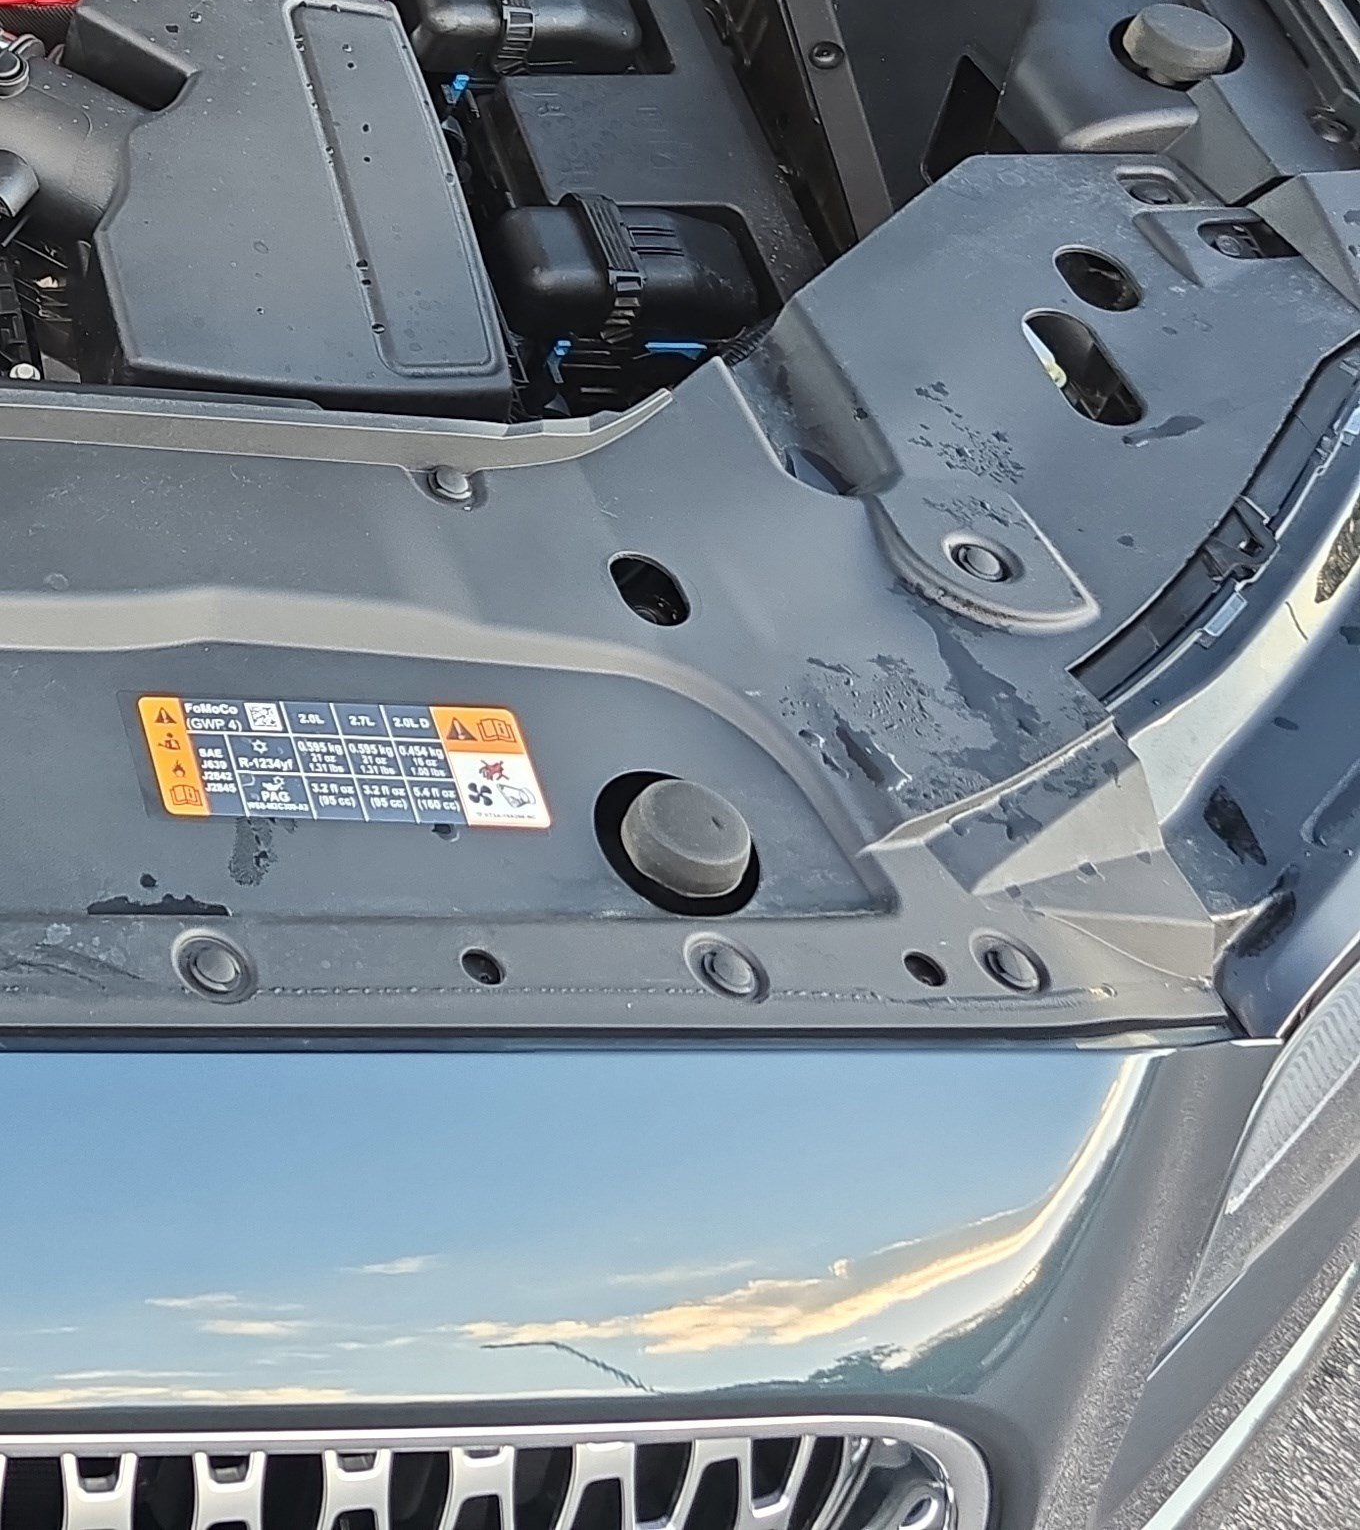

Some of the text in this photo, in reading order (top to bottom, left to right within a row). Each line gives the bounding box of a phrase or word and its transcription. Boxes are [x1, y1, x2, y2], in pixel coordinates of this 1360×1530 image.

[184, 702, 239, 715] FoMoCo
[298, 713, 325, 725] 2.0L
[349, 715, 376, 727] 2.7L
[392, 717, 430, 729] 2.0L D
[198, 748, 224, 759] SAE
[297, 740, 345, 756] 0.595 kg
[348, 743, 394, 758] 0.595 kg
[398, 745, 445, 760] 0.454 kg
[238, 757, 294, 772] R-1234yf
[310, 753, 337, 763] 21 oz
[361, 755, 388, 765] 21 oz
[425, 758, 438, 767] oz
[201, 760, 228, 770] J639
[309, 763, 345, 773] 1.31 lbs
[360, 764, 396, 775] 1.31 lbs
[429, 767, 446, 777] lbs
[310, 782, 355, 795] 3.2 fl oz
[362, 784, 406, 797] 3.2 fl oz
[412, 786, 457, 799] 5.4 fl oz
[260, 790, 292, 803] PAG
[338, 796, 357, 809] cc)
[389, 797, 408, 811] cc)
[417, 798, 462, 813] (160 cc)
